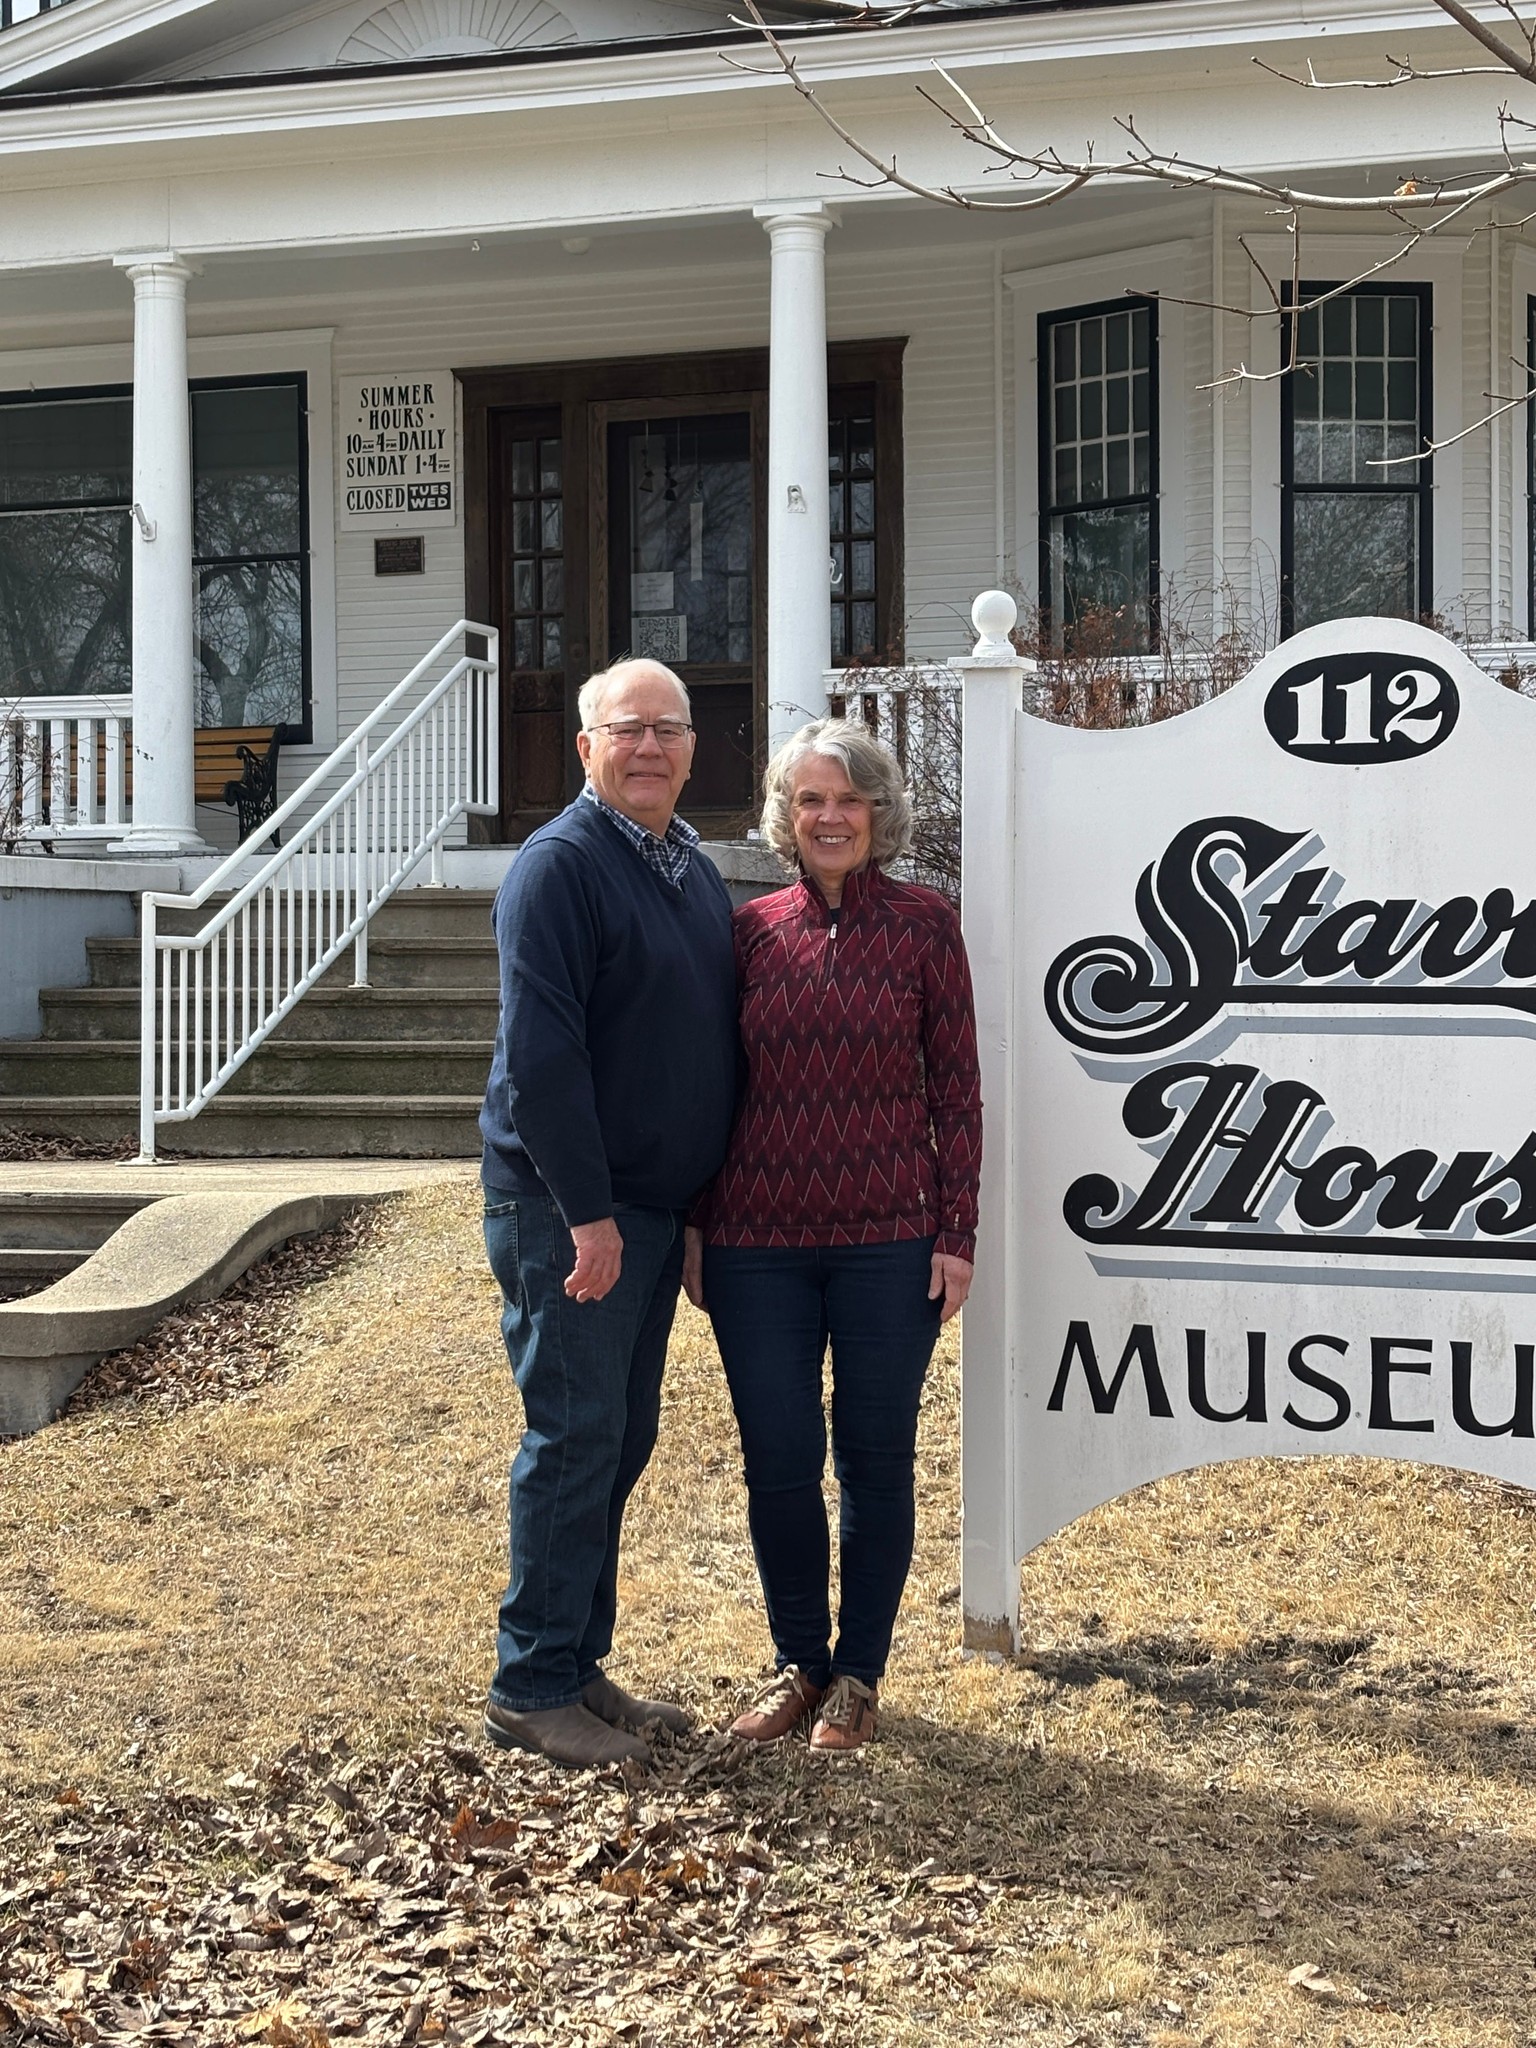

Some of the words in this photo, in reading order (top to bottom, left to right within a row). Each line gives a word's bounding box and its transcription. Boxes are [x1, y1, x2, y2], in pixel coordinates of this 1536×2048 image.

[360, 384, 434, 408] SUMMER
[369, 407, 424, 430] HOURS
[399, 428, 446, 451] DAILY
[346, 454, 408, 478] SUNDAY
[346, 487, 405, 511] CLOSED
[409, 484, 449, 497] TUES
[410, 497, 448, 509] WED
[1287, 669, 1443, 745] 112
